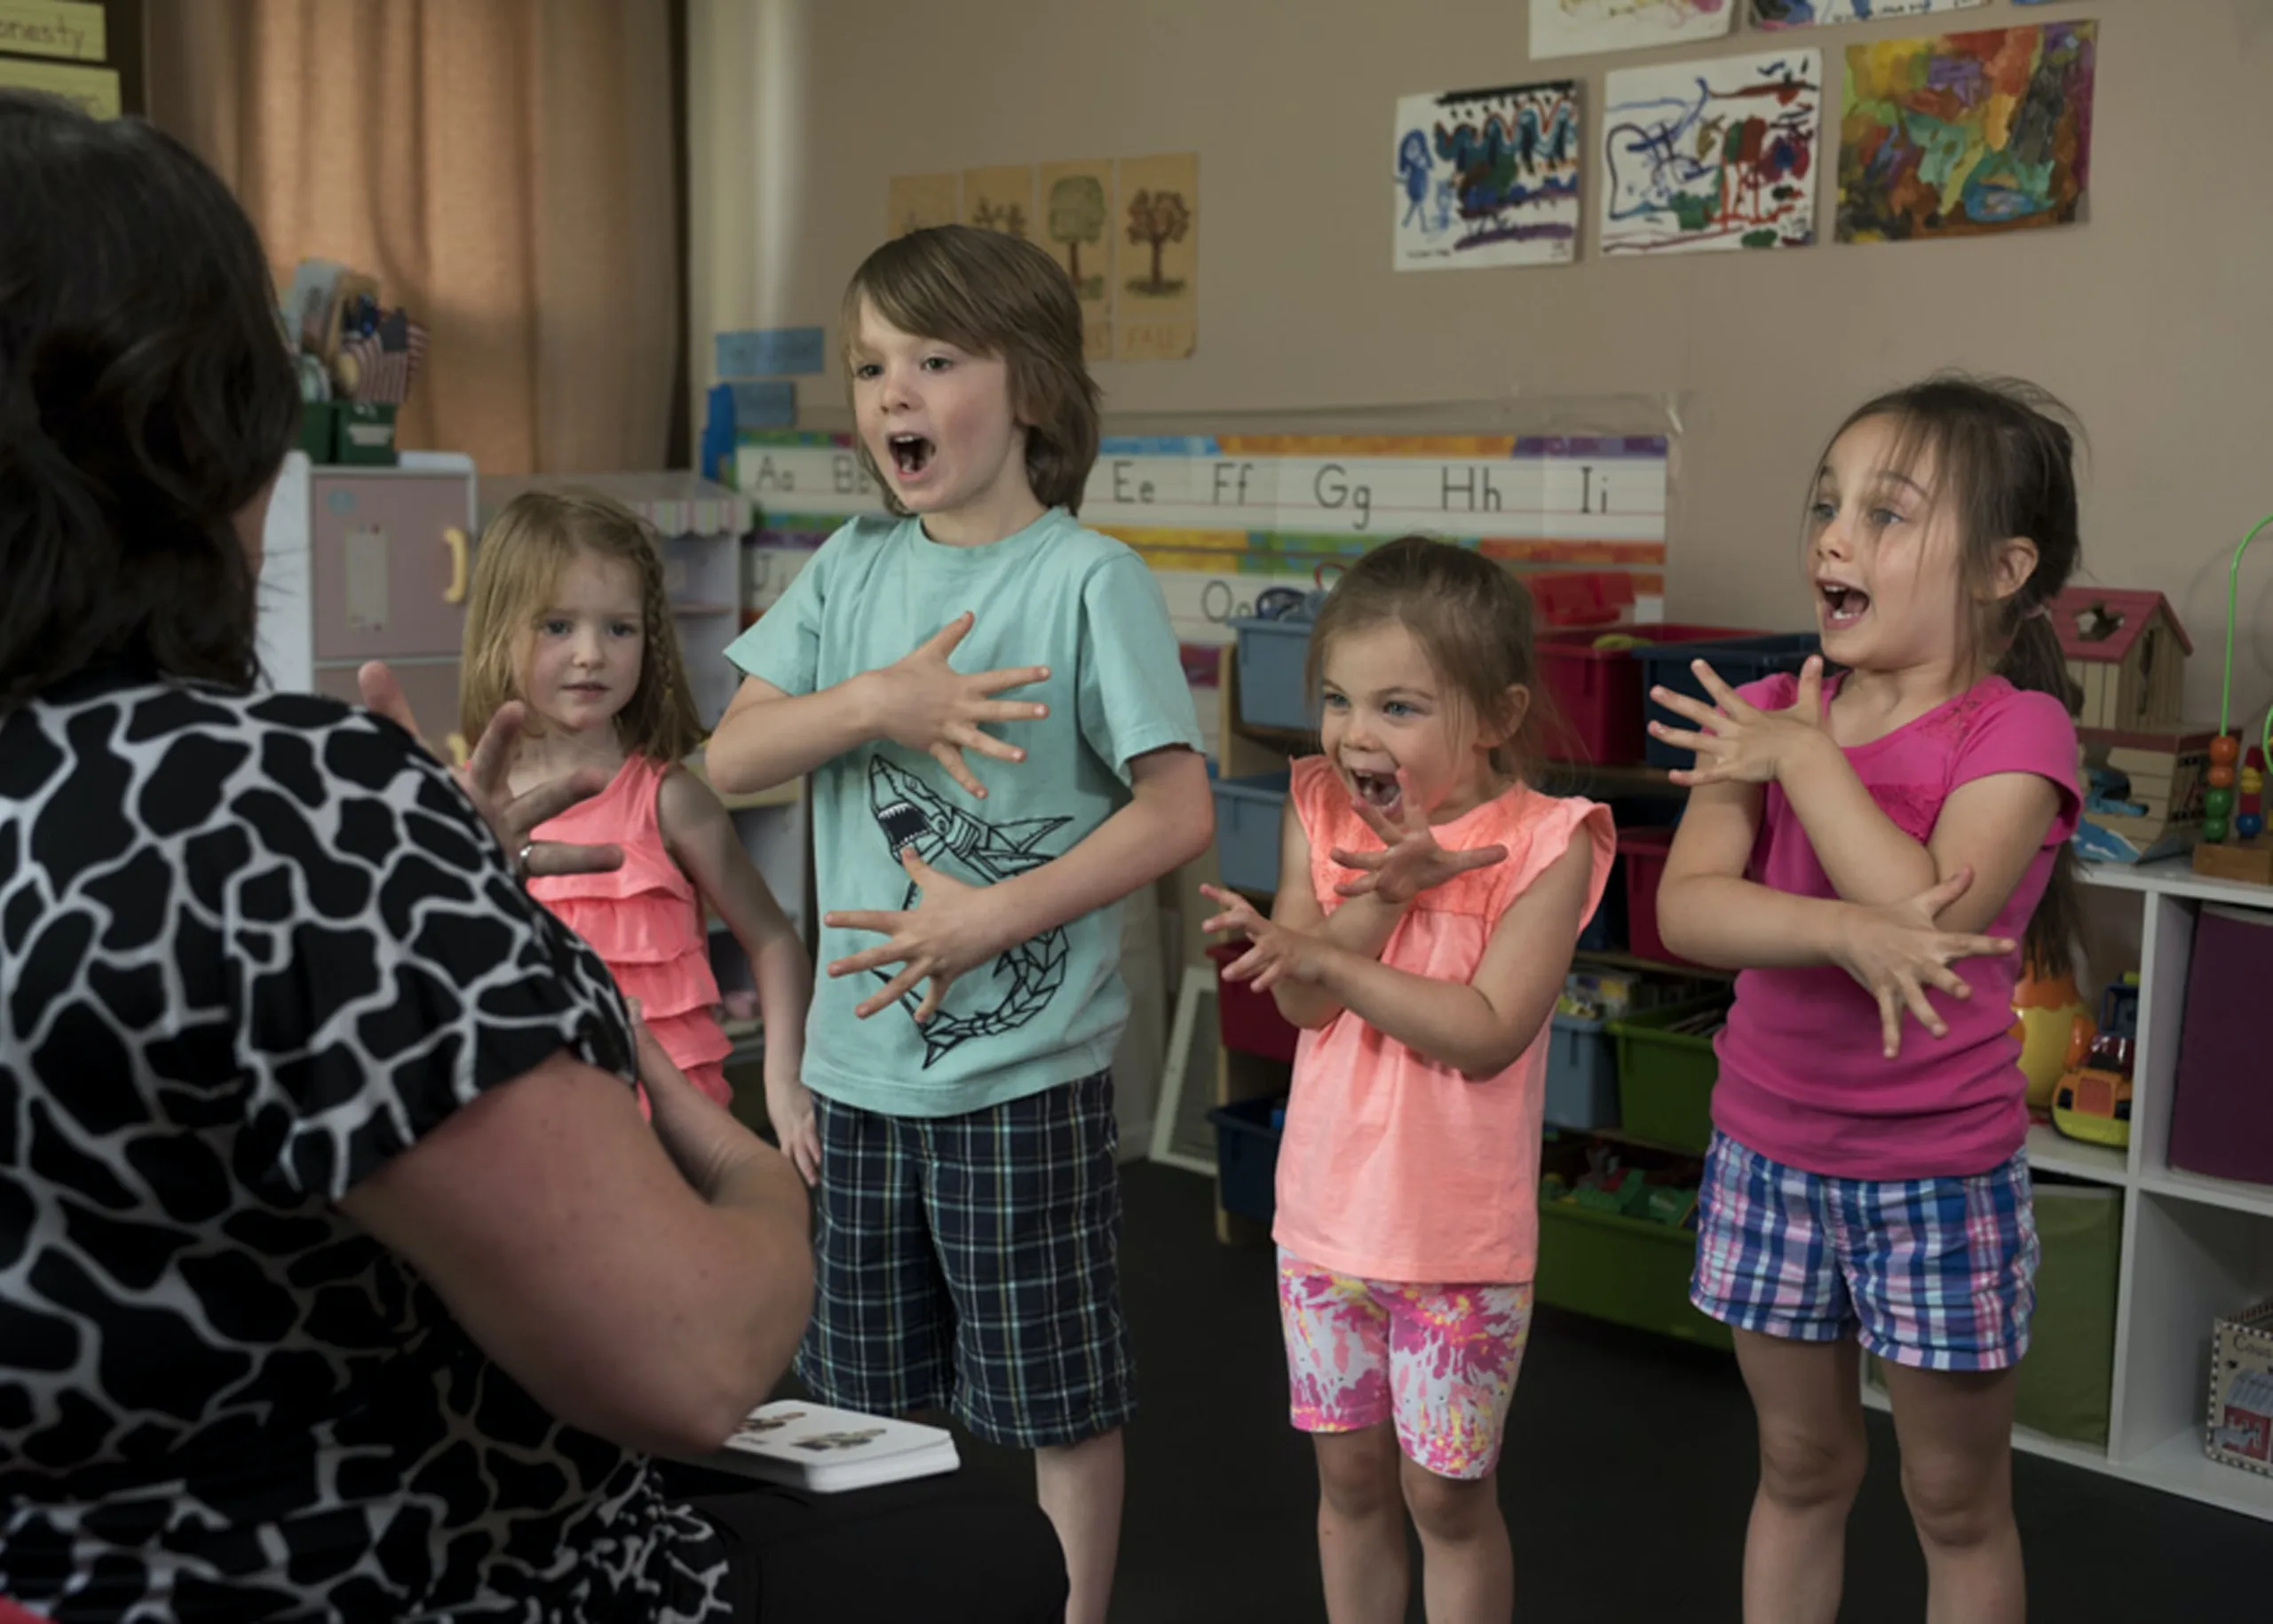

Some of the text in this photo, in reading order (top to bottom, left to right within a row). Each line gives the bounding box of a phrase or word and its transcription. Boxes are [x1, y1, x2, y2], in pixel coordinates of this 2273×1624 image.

[755, 454, 796, 492] Aa
[1113, 461, 1154, 504] Ee
[1213, 462, 1254, 506] Ff
[1313, 463, 1372, 530] Gg
[1441, 465, 1502, 511] Hh
[1580, 466, 1608, 514] Ii
